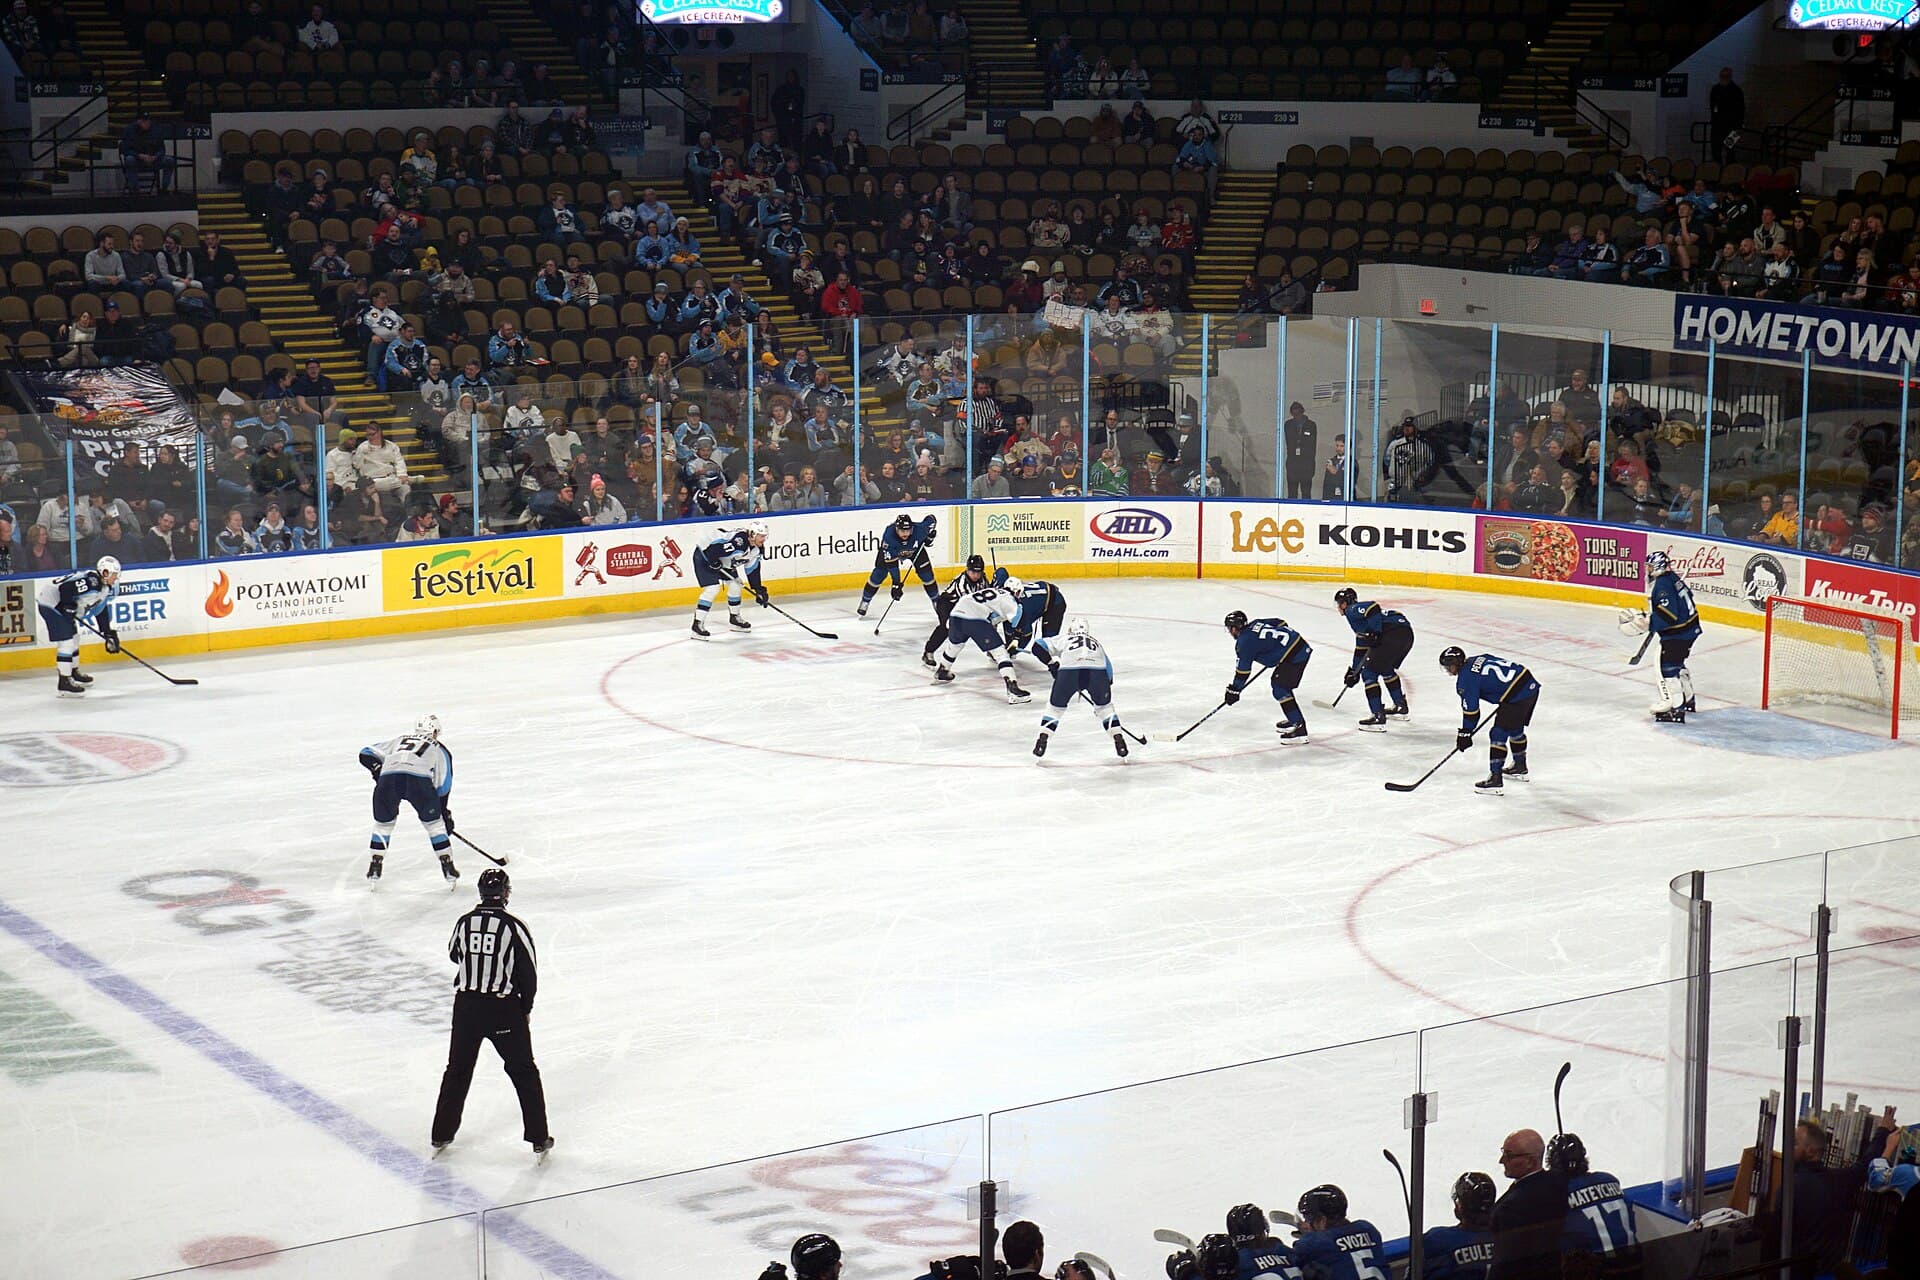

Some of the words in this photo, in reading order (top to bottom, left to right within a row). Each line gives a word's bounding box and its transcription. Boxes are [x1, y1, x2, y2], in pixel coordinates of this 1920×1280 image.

[682, 14, 699, 22] ICE
[703, 12, 742, 21] CREAM
[1807, 0, 1855, 16] CEDAR
[1859, 0, 1904, 15] CREST
[1827, 19, 1842, 28] ICE
[1846, 17, 1882, 28] CREAM
[184, 127, 202, 137] 27
[1680, 304, 1920, 365] HOMETOWN
[1013, 513, 1034, 521] VISIT
[1013, 520, 1071, 531] MILWAUKEE
[1104, 516, 1157, 534] AHL
[1230, 511, 1305, 554] Lee
[1318, 524, 1467, 553] KOHL'S
[762, 542, 810, 560] urora
[818, 530, 881, 555] Health
[1091, 547, 1170, 557] TheAHL.com
[1620, 547, 1630, 558] OF
[610, 557, 648, 568] STANDARD
[613, 550, 645, 560] CENTRAL
[1667, 545, 1725, 570] endik's
[411, 556, 536, 599] festival
[1585, 558, 1640, 579] TOPPINGS
[119, 582, 145, 594] THAT'S
[147, 580, 166, 592] ALL
[236, 575, 366, 601] POTAWATOMI
[1690, 582, 1711, 593] REAL
[1712, 585, 1740, 598] PEOPLE
[256, 598, 300, 610] CASINO
[308, 594, 345, 605] HOTEL
[1868, 588, 1917, 616] TRIP
[271, 606, 335, 619] MILWAUKEE
[469, 932, 497, 955] 88
[1567, 1182, 1624, 1209] MATEYCHU
[1582, 1198, 1636, 1258] 17
[1336, 1232, 1377, 1251] SVOZIL
[1254, 1254, 1291, 1270] HUNT
[1454, 1243, 1496, 1265] CEULE
[1350, 1248, 1387, 1280] 5
